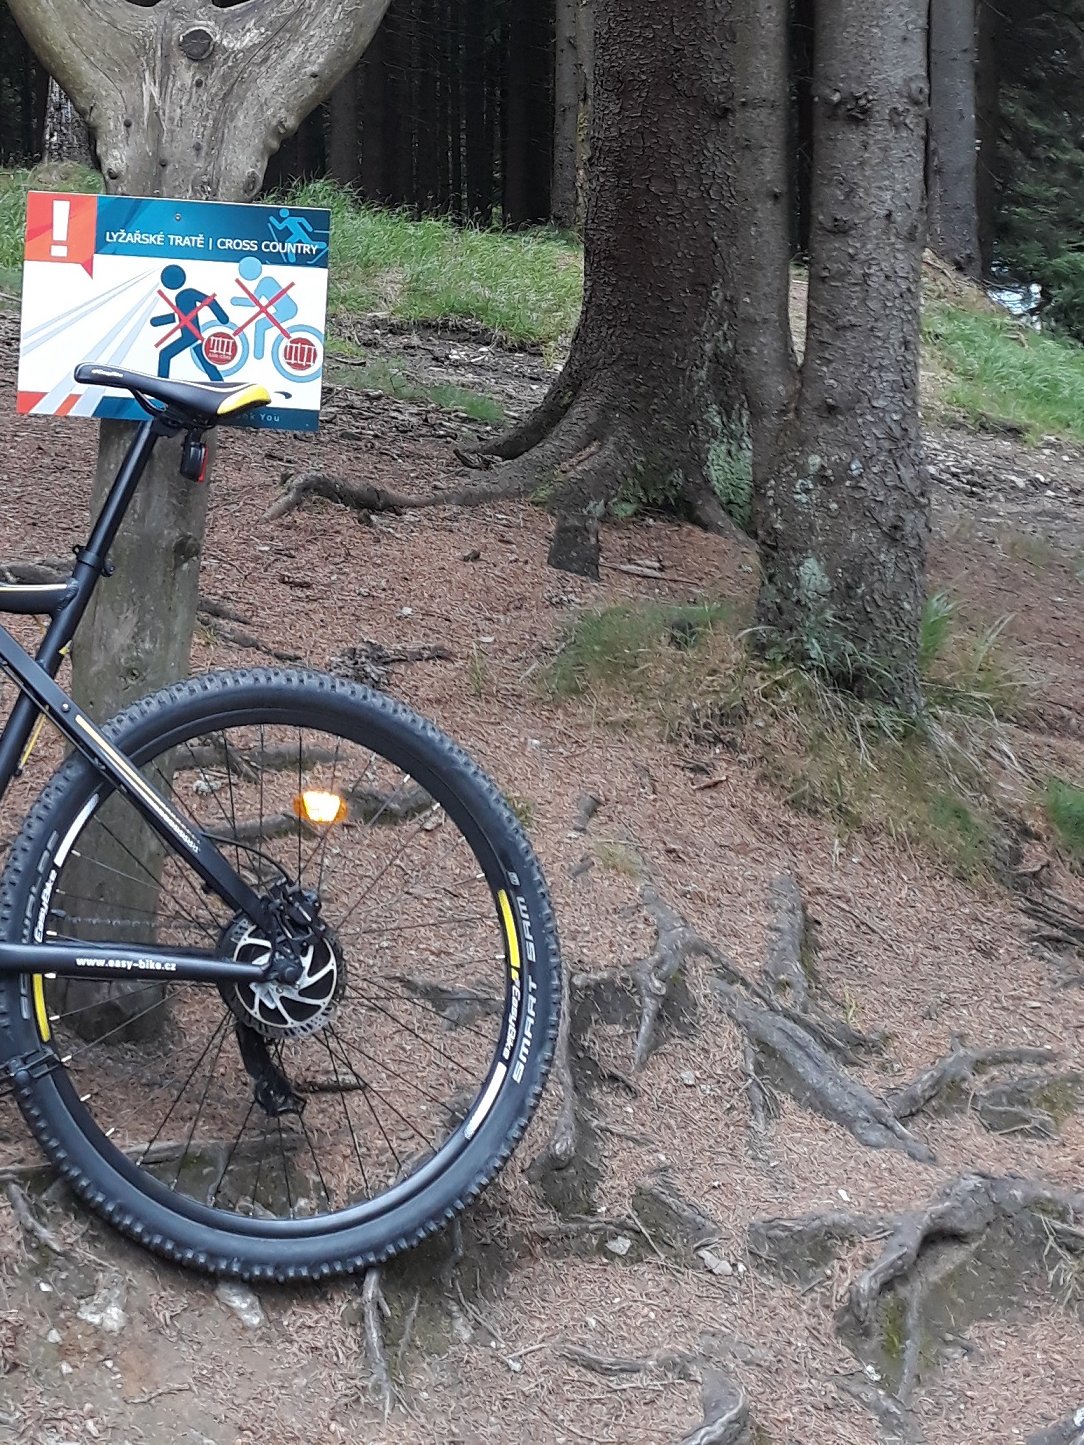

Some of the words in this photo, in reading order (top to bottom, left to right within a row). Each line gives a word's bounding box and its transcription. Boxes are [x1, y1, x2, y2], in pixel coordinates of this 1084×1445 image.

[105, 229, 165, 245] LYŽAŘSKÉ
[168, 234, 205, 248] TRATĚ
[217, 238, 258, 252] CROSS
[261, 241, 319, 256] COUNTRY
[259, 413, 280, 422] You
[75, 957, 177, 971] www.easy-bike.cz
[512, 975, 538, 1084] SMART
